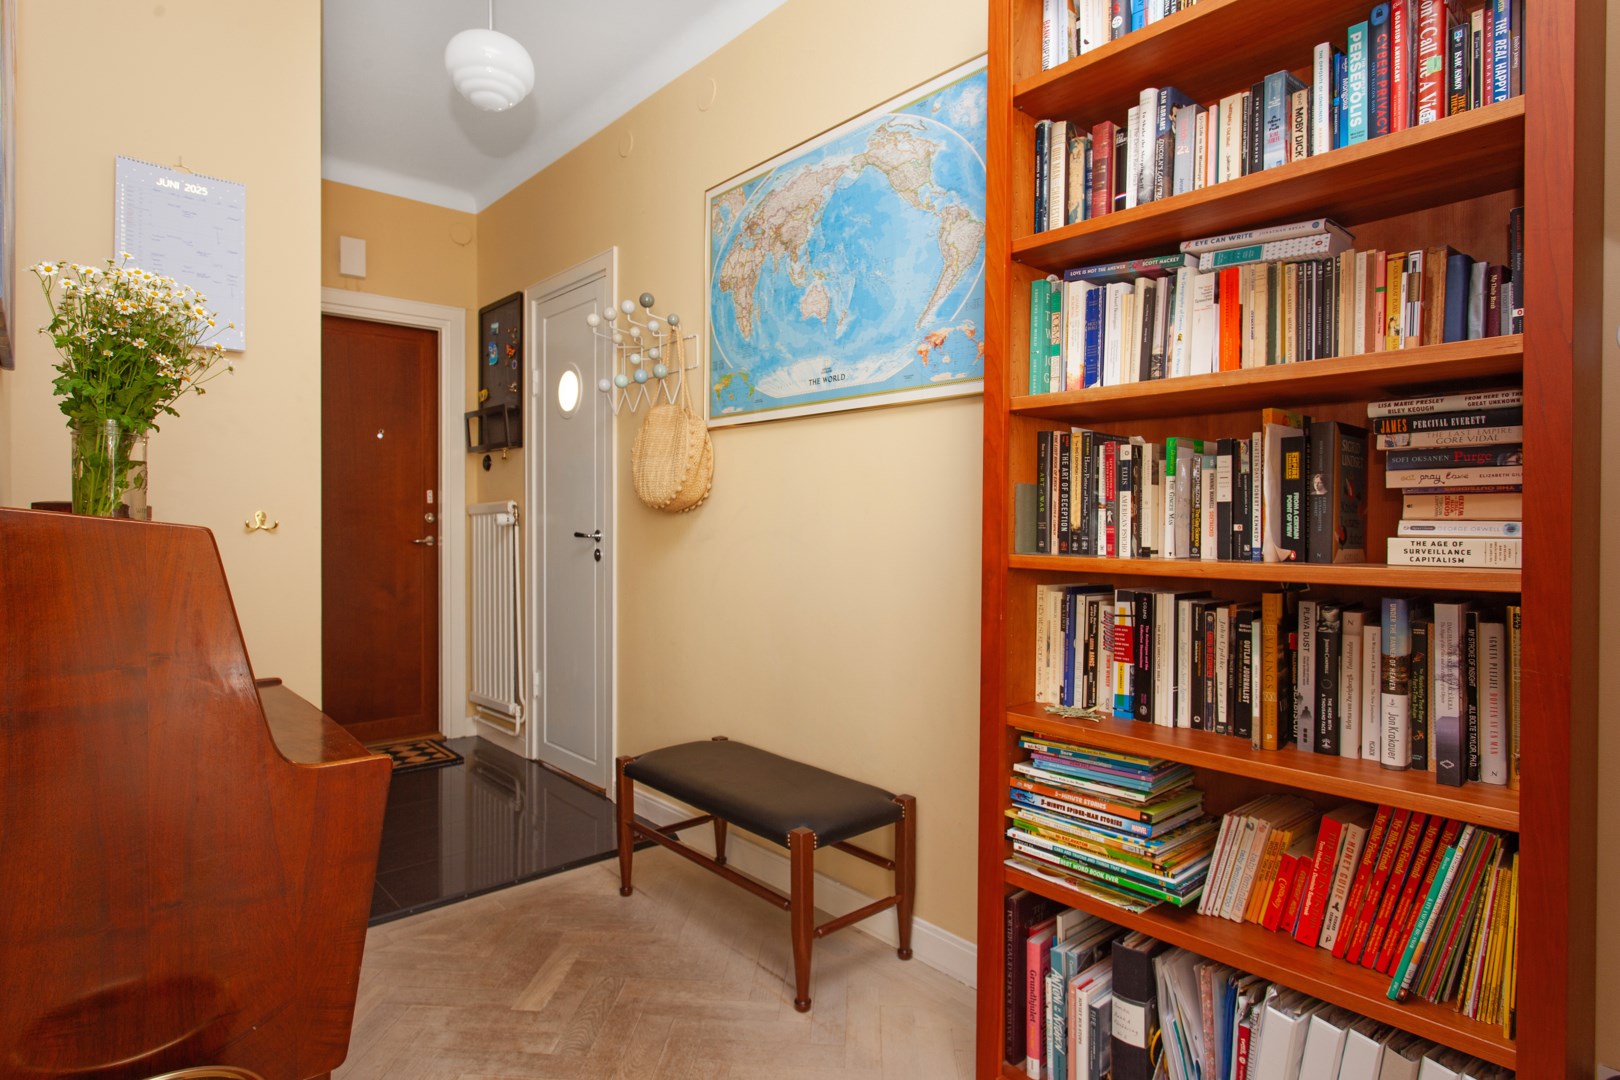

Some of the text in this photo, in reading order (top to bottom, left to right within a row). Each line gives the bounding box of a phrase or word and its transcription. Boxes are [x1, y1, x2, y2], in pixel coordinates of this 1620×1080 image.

[1420, 26, 1438, 93] Call A
[1494, 17, 1508, 93] THE REAL HAPPY
[1350, 32, 1363, 127] PERSEPOLIS
[1377, 34, 1388, 134] CYBER PRIVACY
[1159, 106, 1167, 131] ABRAMS
[1295, 107, 1304, 158] MOBY DICK
[1156, 138, 1165, 170] LINCOLN'S
[1176, 145, 1190, 155] 22
[156, 177, 208, 196] JUNI 2025
[1194, 232, 1253, 247] EYE CAN WRITE
[1259, 228, 1287, 236] JONATHAN
[1142, 257, 1180, 267] SCOTT MACKEY
[1070, 269, 1082, 277] LOVE
[1052, 312, 1060, 345] POEMS
[808, 373, 847, 387] THE WORLD
[1393, 400, 1414, 408] MARIE
[1415, 398, 1445, 406] PRESLEY
[1464, 394, 1483, 402] FROM
[1489, 398, 1521, 406] UNKNOWN
[1388, 406, 1435, 415] RILEY KEOUGH
[1380, 416, 1486, 434] JAMES PERCIVAL EVERETT
[1426, 431, 1447, 439] THE
[1436, 434, 1500, 445] GORE VIDAL
[1411, 455, 1450, 463] OKSANEN
[1454, 452, 1493, 464] Purge
[1061, 452, 1069, 533] THE ART OF DECEPTION
[1470, 523, 1500, 532] ORWELL
[1303, 607, 1311, 631] PLAYA
[1102, 610, 1115, 652] DANUBIA
[1490, 637, 1498, 660] AGNETA
[1242, 640, 1250, 704] OUTLAW JOURNALIST
[1265, 637, 1274, 689] VIKINGS
[1390, 660, 1396, 668] OF
[1387, 712, 1399, 760] Jon Krakauer
[1469, 733, 1477, 753] TAYLOR,
[1490, 731, 1498, 739] EN
[1490, 742, 1498, 755] MAN
[1054, 792, 1107, 810] 5-MINUTE STORIES
[1041, 798, 1123, 827] 5-MINUTE SPIDER-MAN STORIES
[1131, 824, 1148, 835] MARVEL
[1362, 812, 1386, 867] My Bible Friends
[1378, 817, 1402, 872] My Bible Friends
[1394, 820, 1420, 876] My Bible Friends
[1410, 824, 1437, 880] My Bible Friends
[1236, 849, 1247, 864] baby
[1245, 852, 1258, 871] baby
[1313, 851, 1323, 868] Holland
[1059, 859, 1119, 883] BEST WORD BOOK EVER
[1333, 840, 1356, 900] HONEY GUIDE
[1029, 970, 1038, 1024] Grundhjulet
[1051, 968, 1065, 1056] ANTONI KITCHEN
